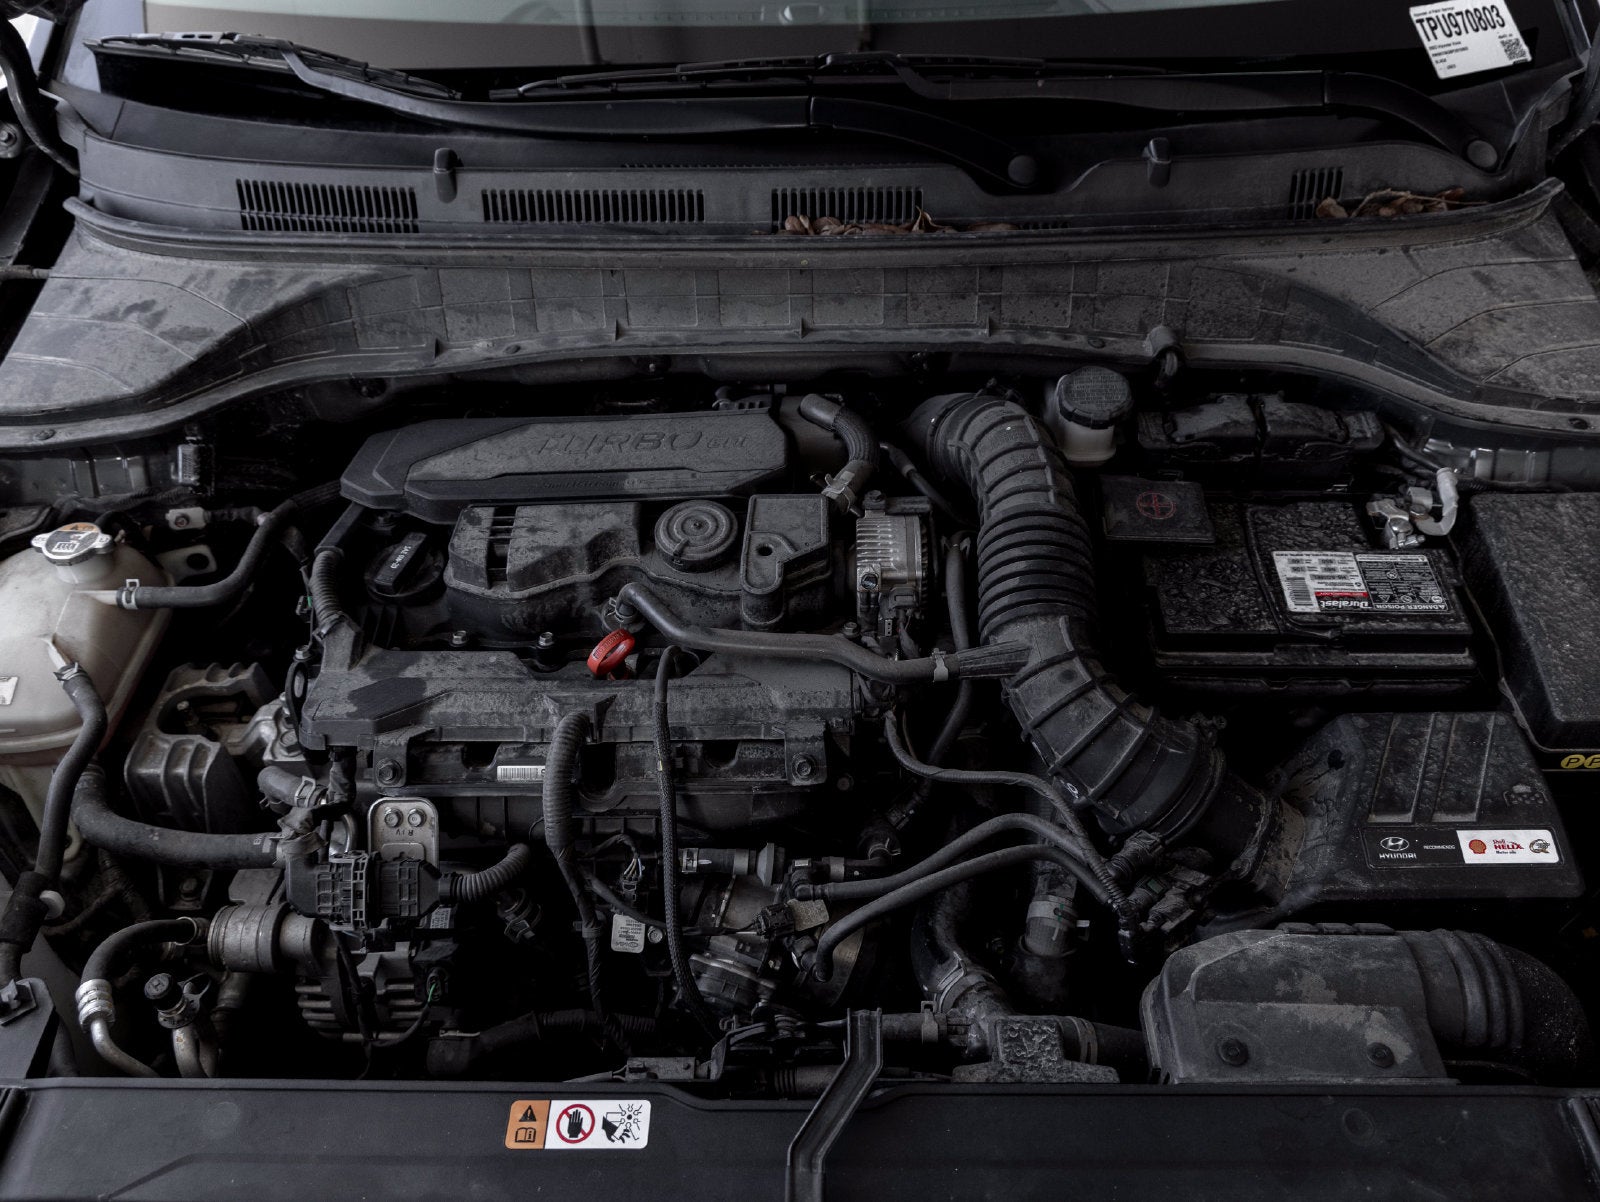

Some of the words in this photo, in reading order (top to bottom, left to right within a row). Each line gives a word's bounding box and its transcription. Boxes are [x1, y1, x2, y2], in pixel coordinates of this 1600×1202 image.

[1416, 5, 1505, 41] TPU970803
[537, 431, 703, 458] TURBO
[1320, 600, 1372, 609] Duralast
